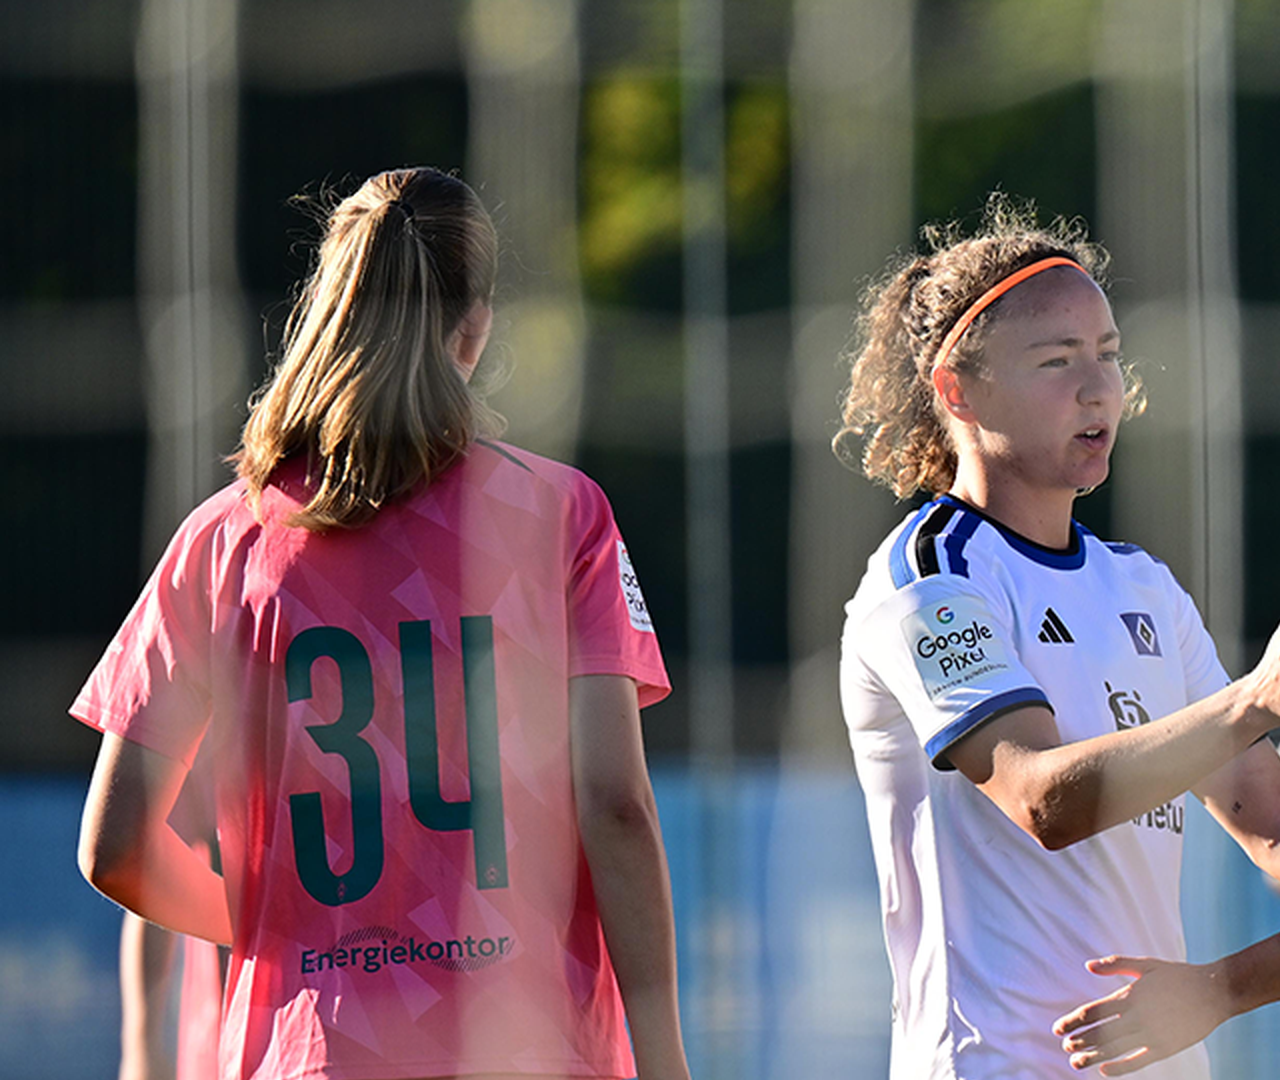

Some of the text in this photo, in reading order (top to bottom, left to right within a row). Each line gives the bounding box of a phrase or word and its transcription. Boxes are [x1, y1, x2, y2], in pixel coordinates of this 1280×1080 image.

[917, 620, 993, 659] Google
[939, 648, 986, 678] Pixel
[285, 615, 509, 907] 34
[301, 934, 510, 975] Energiekontor
